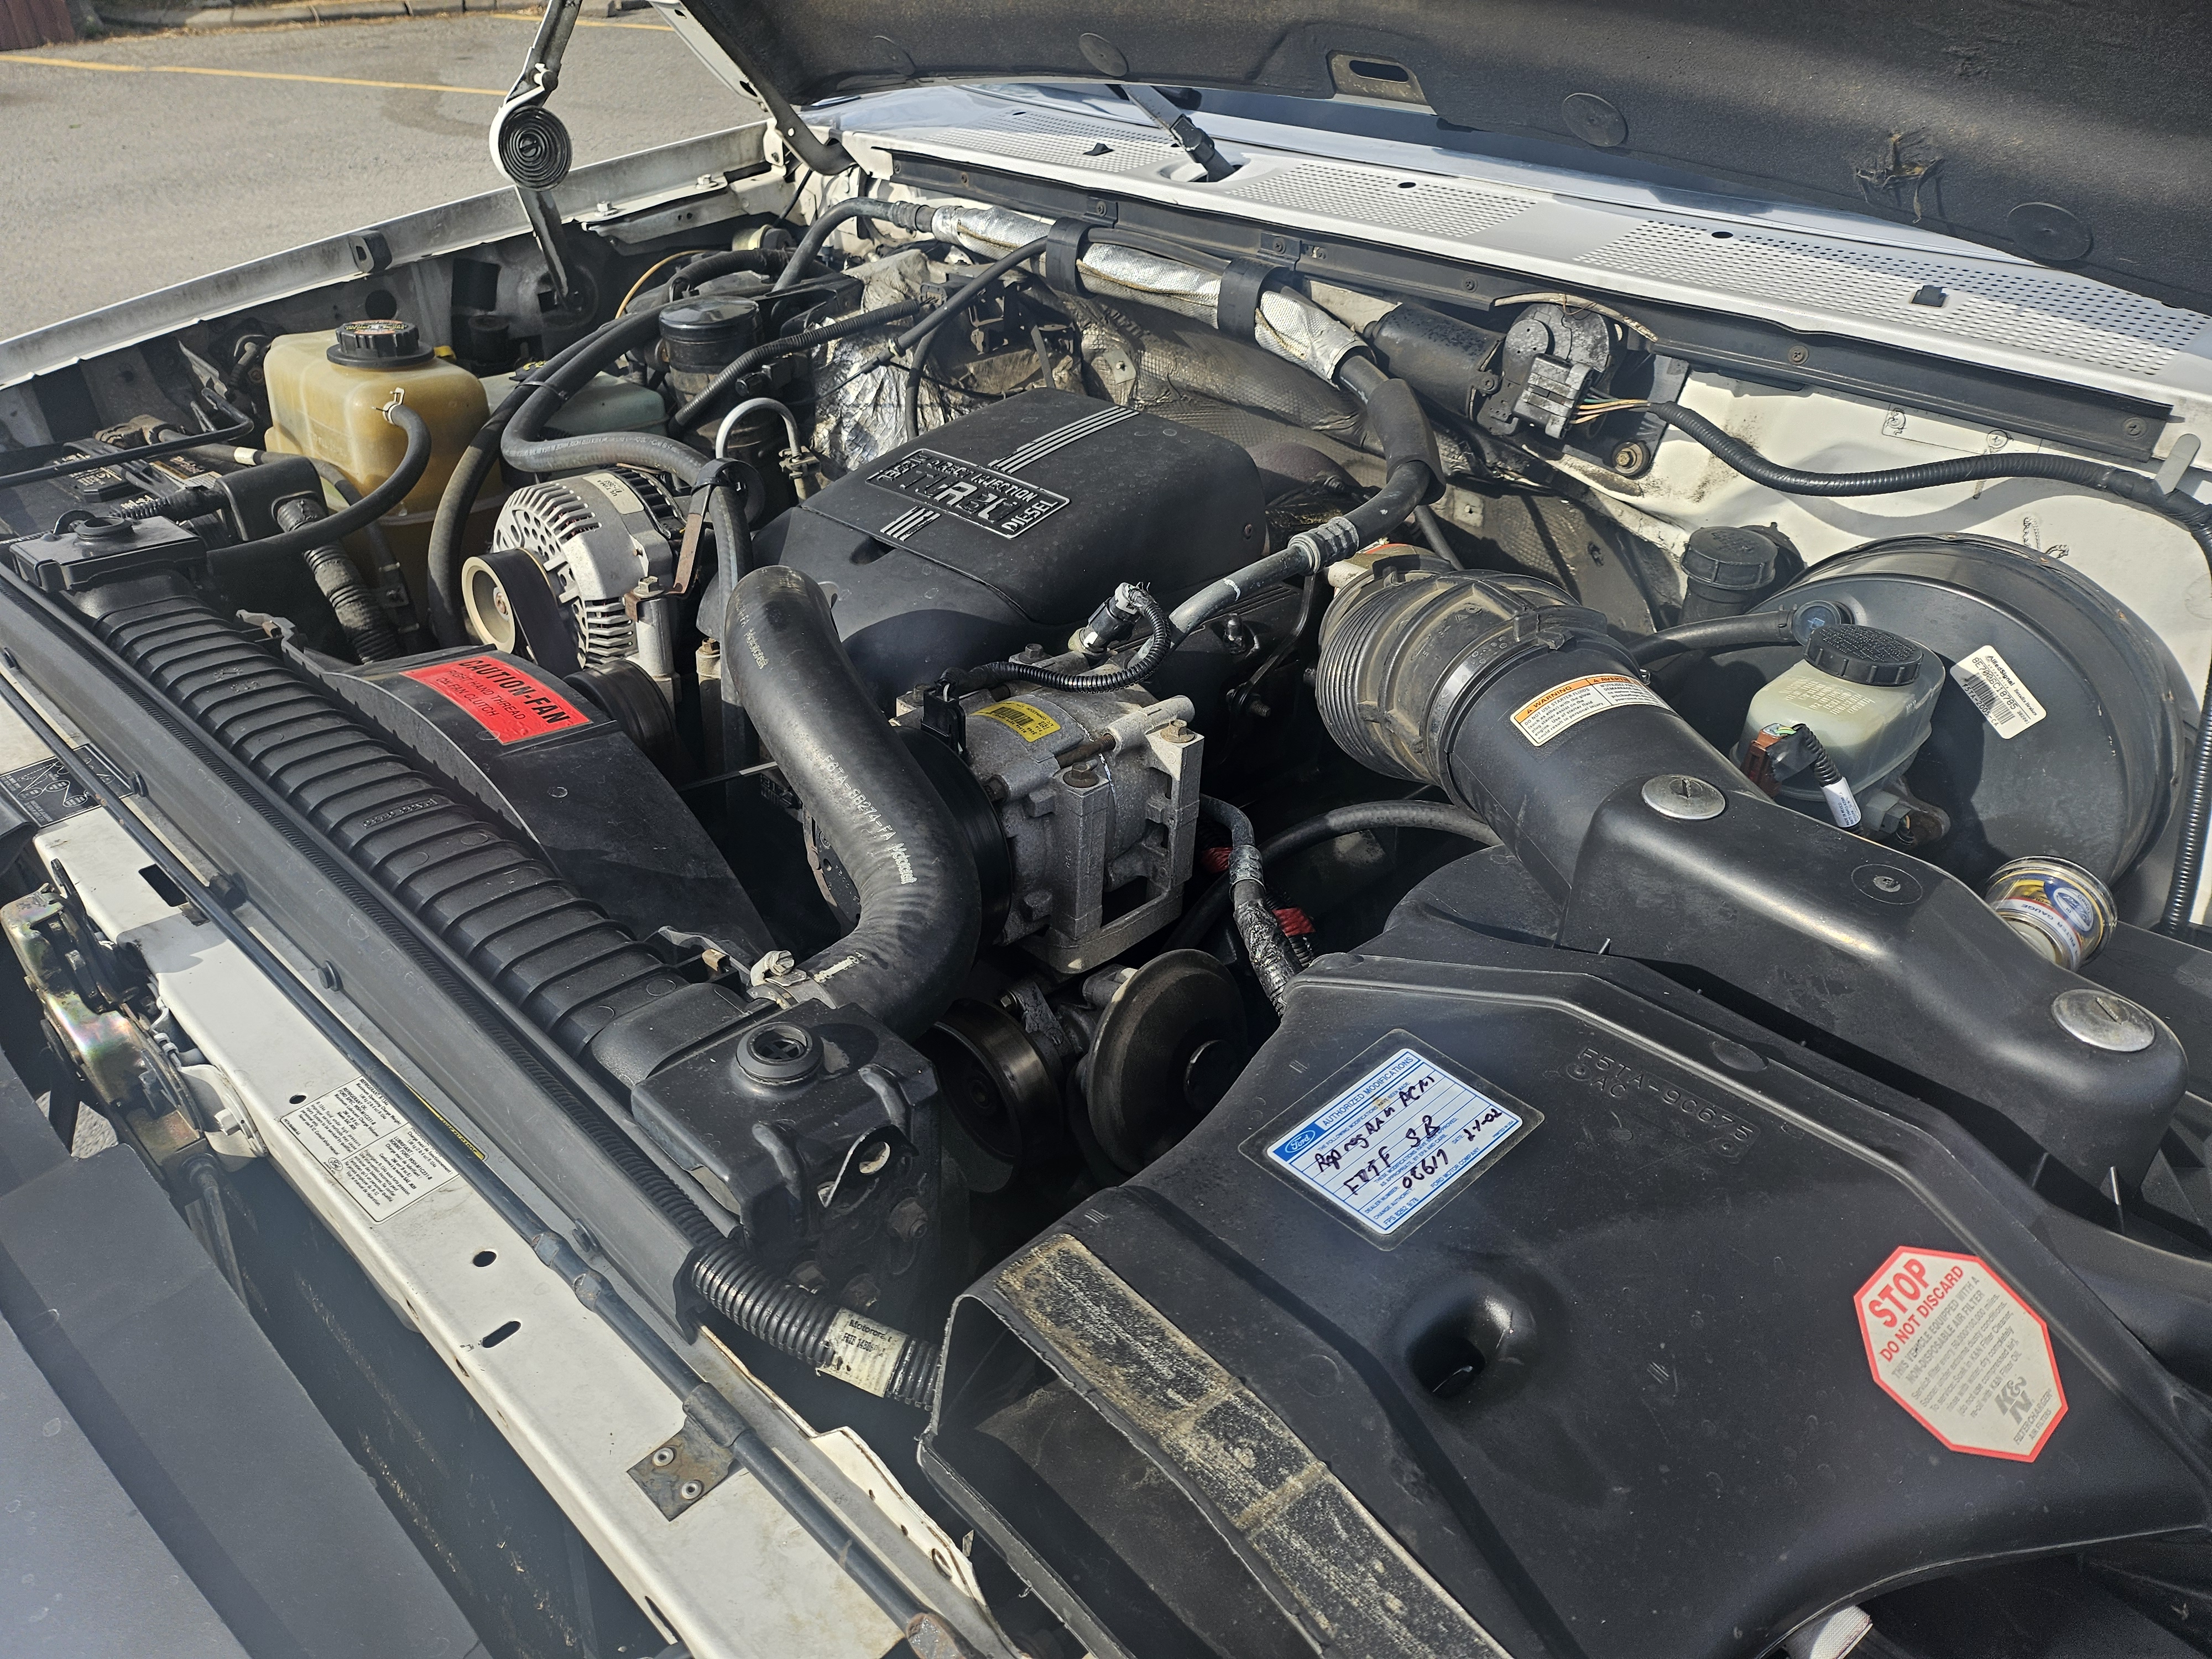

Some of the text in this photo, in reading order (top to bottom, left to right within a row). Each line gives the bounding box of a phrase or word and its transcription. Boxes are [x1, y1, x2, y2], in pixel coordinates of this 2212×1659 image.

[900, 471, 1020, 523] TURBO
[971, 473, 1038, 502] INJECTION
[1001, 500, 1058, 532] DIESEL
[448, 684, 469, 693] FAN
[463, 693, 499, 716] CLUTCH
[458, 658, 571, 724] CAUTION-FAN
[468, 681, 494, 695] HAND
[491, 695, 525, 719] THREAD
[1533, 686, 1572, 707] WARNING
[1551, 695, 1573, 706] STARTER
[1573, 688, 1590, 696] FLUIDS
[2014, 688, 2027, 703] Bendix
[1551, 721, 1564, 730] result
[1569, 708, 1589, 719] personal
[888, 842, 917, 884] Motorcraft
[2021, 904, 2075, 947] FILTER GAUGE
[1287, 1057, 1413, 1150] Ford AUTHORIZED MODIFICATIONS
[1578, 1048, 1754, 1141] F5TA-9C675
[1590, 1077, 1626, 1097] AC
[407, 1131, 418, 1141] Charge
[1326, 1127, 1349, 1145] FOLLOWING
[1348, 1105, 1378, 1128] MODIFICATIONS
[1378, 1098, 1389, 1106] HAVE
[393, 1136, 413, 1153] LUBRIFIANT
[400, 1149, 410, 1158] FORD
[1373, 1172, 1388, 1182] THESE
[1387, 1150, 1417, 1173] MODIFICATIONS
[1416, 1141, 1427, 1150] HAVE
[1386, 1161, 1415, 1182] APPROPRIATE,
[1430, 1146, 1480, 1187] FORD MOTOR COMPANY
[1364, 1186, 1400, 1213] DEALER NUMBER:
[1373, 1188, 1415, 1219] CHANGE AUTHORITY:
[1383, 1215, 1396, 1225] FPS
[1869, 1259, 1927, 1327] STOP
[849, 1319, 893, 1342] Motorcrat
[1880, 1266, 1962, 1361] DO NOT DISCARD
[1891, 1276, 1980, 1379] THIS VEHICLE EQUIPPED WITH A
[1906, 1290, 1984, 1384] NON-DISPOSABLE AIR FILTER
[1911, 1377, 1931, 1400] Service
[1927, 1363, 1941, 1378] filter
[1939, 1348, 1955, 1366] every
[1919, 1385, 1938, 1407] Sooner
[1937, 1368, 1952, 1387] under
[1950, 1347, 1969, 1370] extreme
[1967, 1330, 1983, 1348] dusty
[1929, 1404, 1939, 1412] To
[1953, 1366, 1968, 1383] Soak
[1969, 1346, 1983, 1360] K&N
[1979, 1332, 1994, 1349] Filter
[1965, 1393, 1975, 1406] not
[1973, 1383, 1983, 1395] use
[1981, 1348, 2009, 1384] compressed
[1981, 1389, 1993, 1402] with
[1989, 1376, 2002, 1389] K&N
[1999, 1360, 2013, 1377] Filter
[2028, 1408, 2051, 1440] AIR FILTERS
